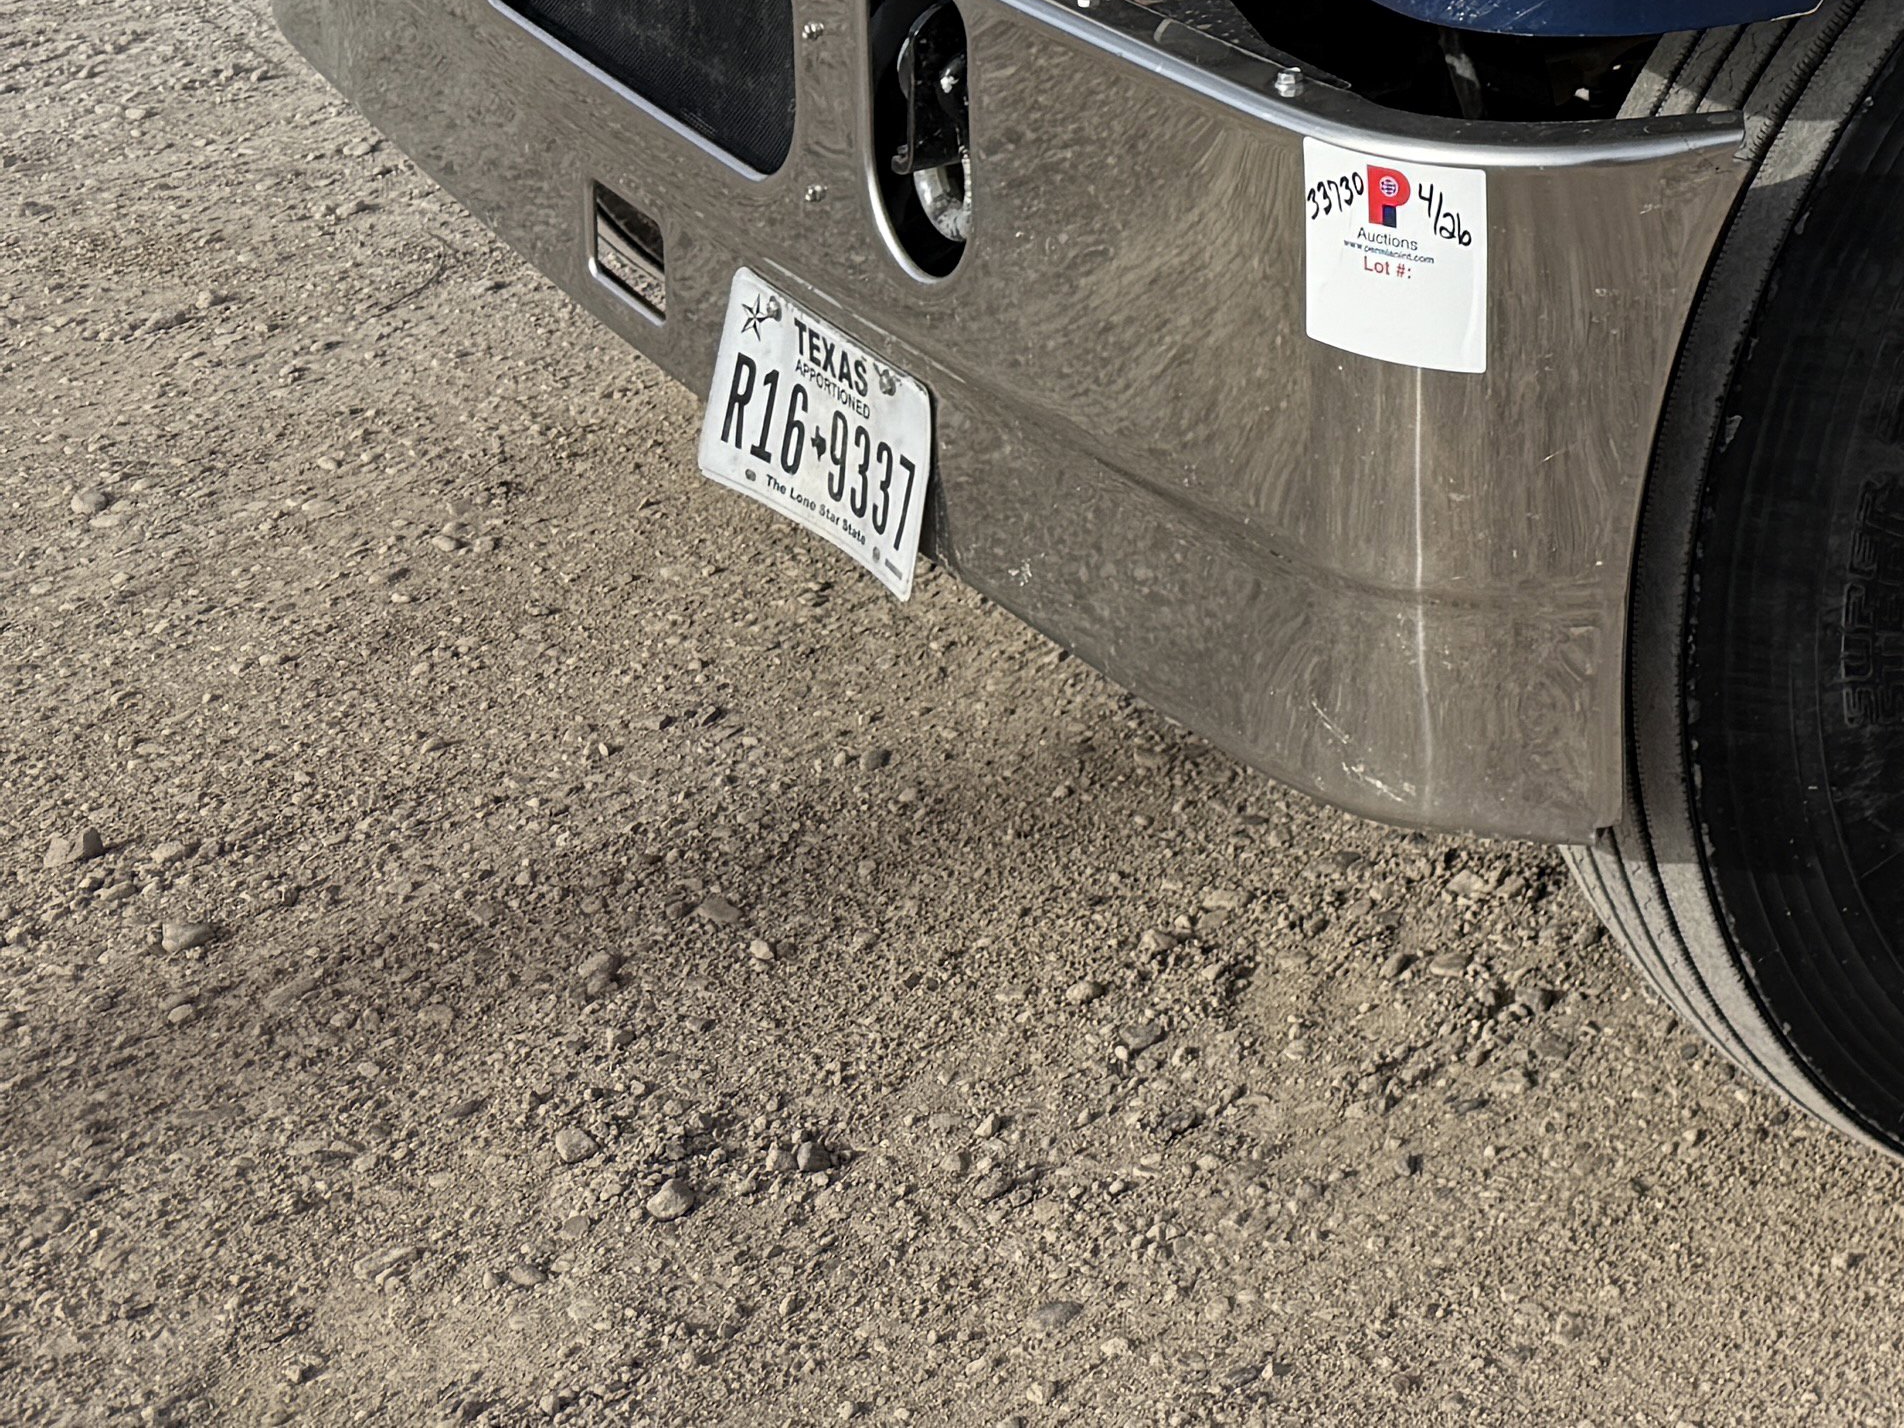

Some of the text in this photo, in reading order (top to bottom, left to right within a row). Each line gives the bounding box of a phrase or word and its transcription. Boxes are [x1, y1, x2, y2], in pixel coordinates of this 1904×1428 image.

[1307, 172, 1364, 220] 33730
[1357, 227, 1418, 251] Auctions
[1364, 255, 1411, 279] Lot #:
[794, 318, 868, 397] TEXAS
[795, 359, 871, 420] APPORTIONED
[766, 473, 867, 546] The Lone Star State
